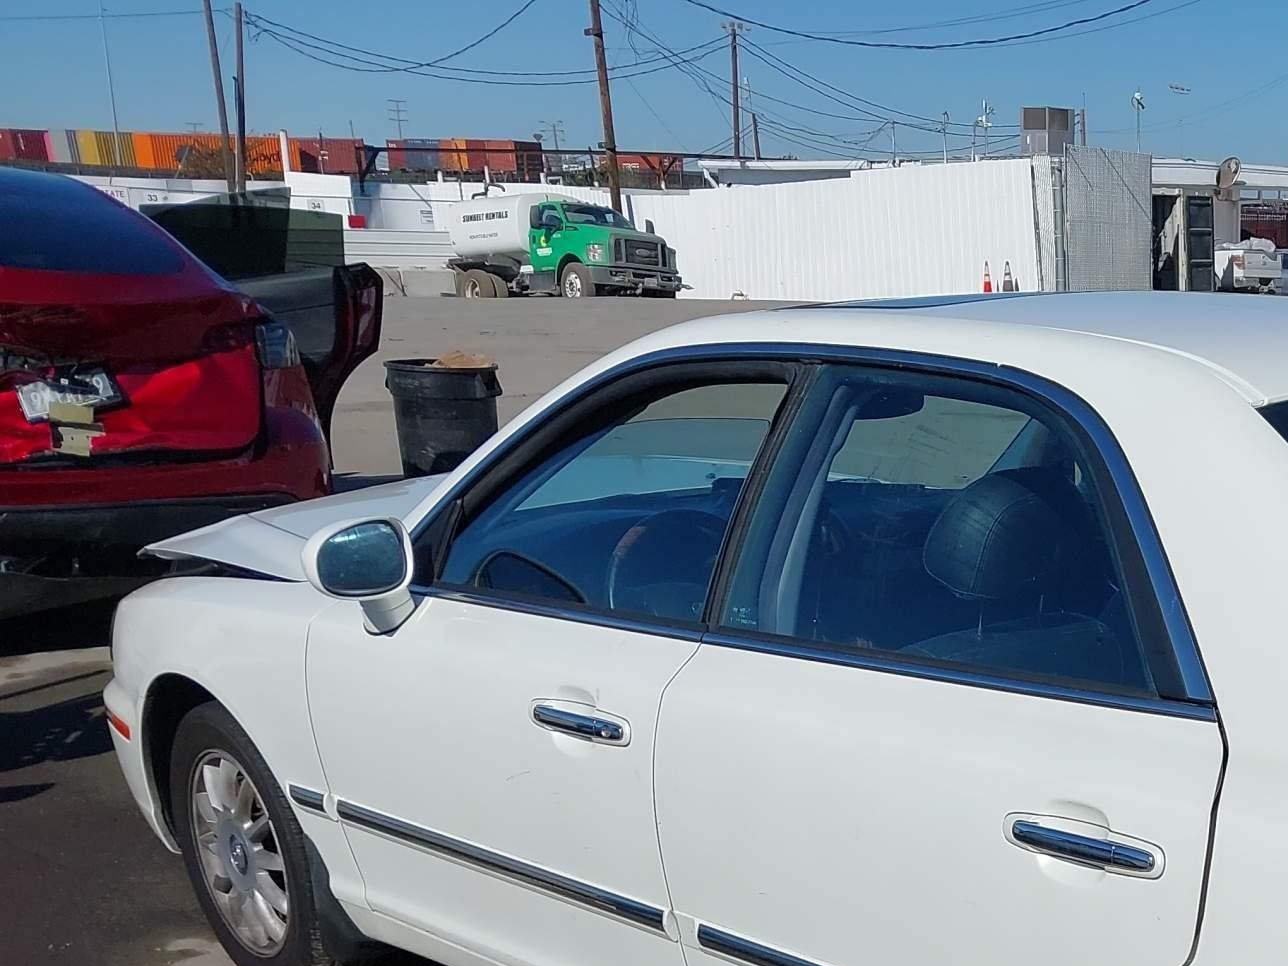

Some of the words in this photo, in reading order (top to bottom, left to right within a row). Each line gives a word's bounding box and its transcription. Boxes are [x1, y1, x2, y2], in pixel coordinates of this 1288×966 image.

[311, 202, 321, 210] 34
[462, 213, 484, 223] SUNBELT
[485, 211, 508, 220] RENTALS
